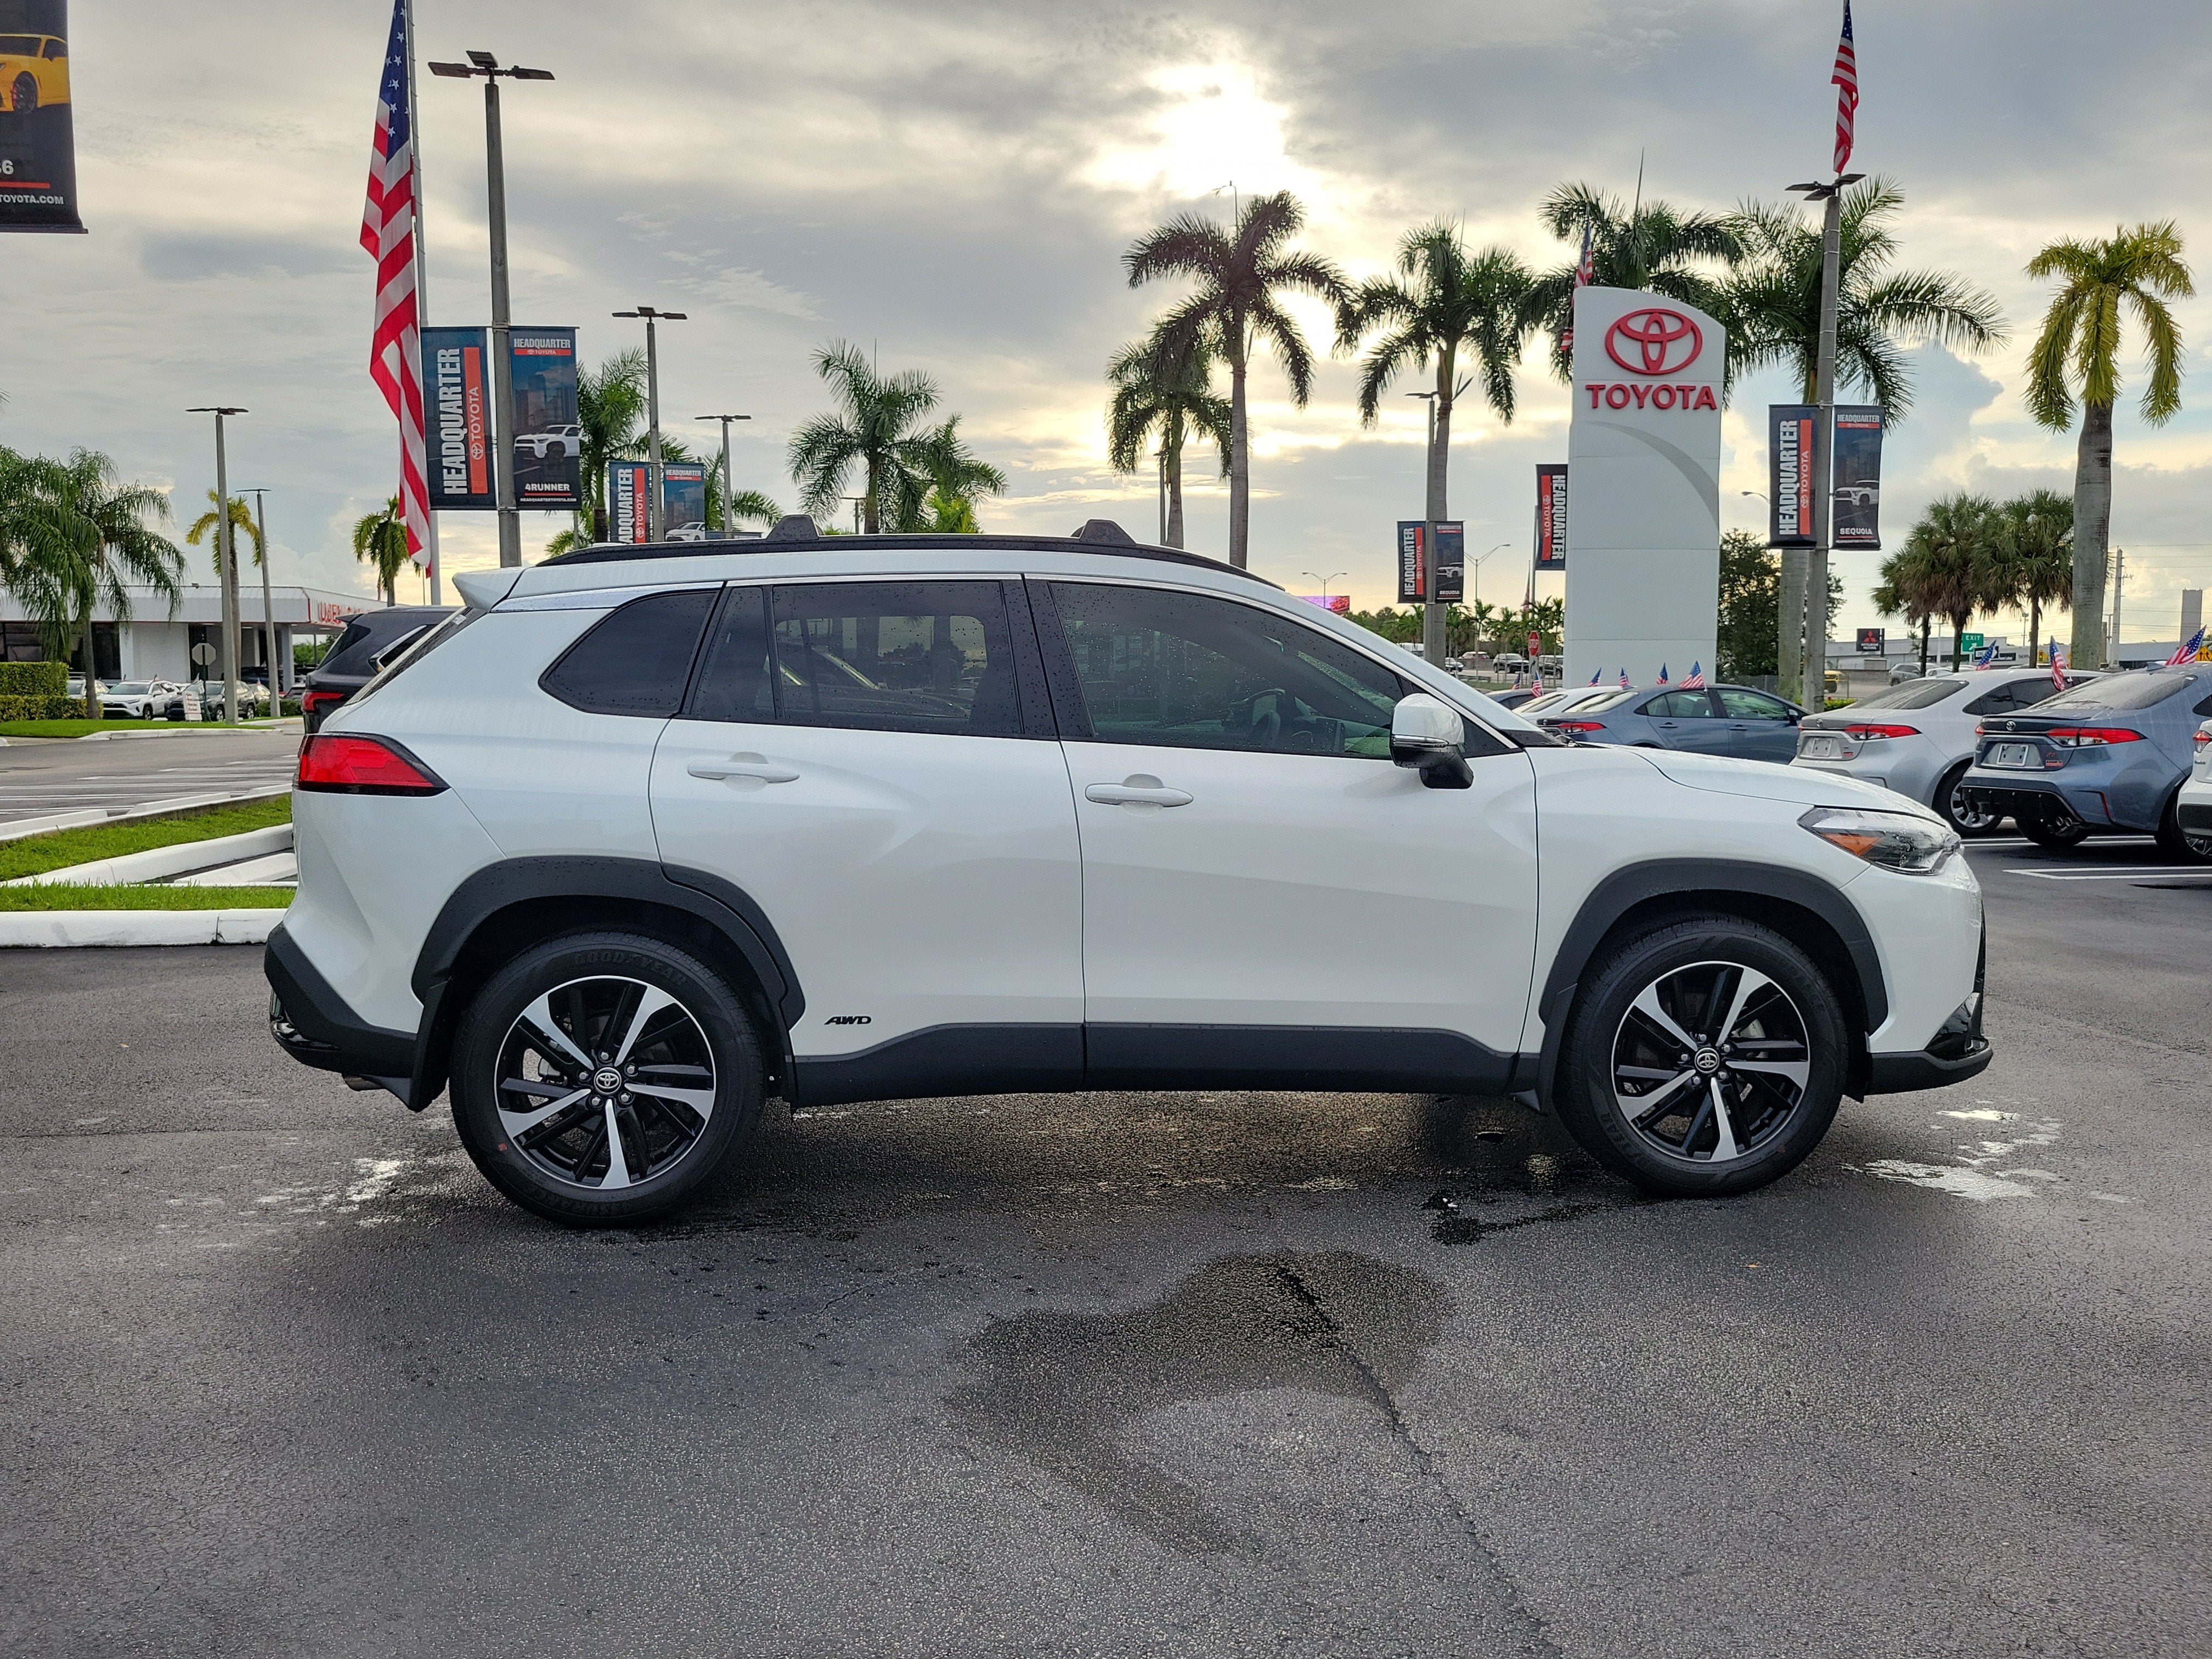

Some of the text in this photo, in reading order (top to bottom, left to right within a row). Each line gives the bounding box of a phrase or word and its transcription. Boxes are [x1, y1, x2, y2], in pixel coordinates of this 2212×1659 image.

[0, 160, 14, 174] 6
[514, 338, 571, 349] HEADQUARTER
[1585, 383, 1717, 410] TOYOTA
[437, 348, 468, 494] HEADQUARTER
[469, 386, 481, 441] TOYOTA
[1837, 414, 1880, 423] HEADQUARTER
[525, 483, 571, 492] 4RUNNER
[1779, 420, 1799, 535] HEADQUARTER
[1551, 475, 1566, 560] HEADQUARTER
[1403, 528, 1417, 595] HEADQUARTER
[824, 1015, 872, 1025] AWD
